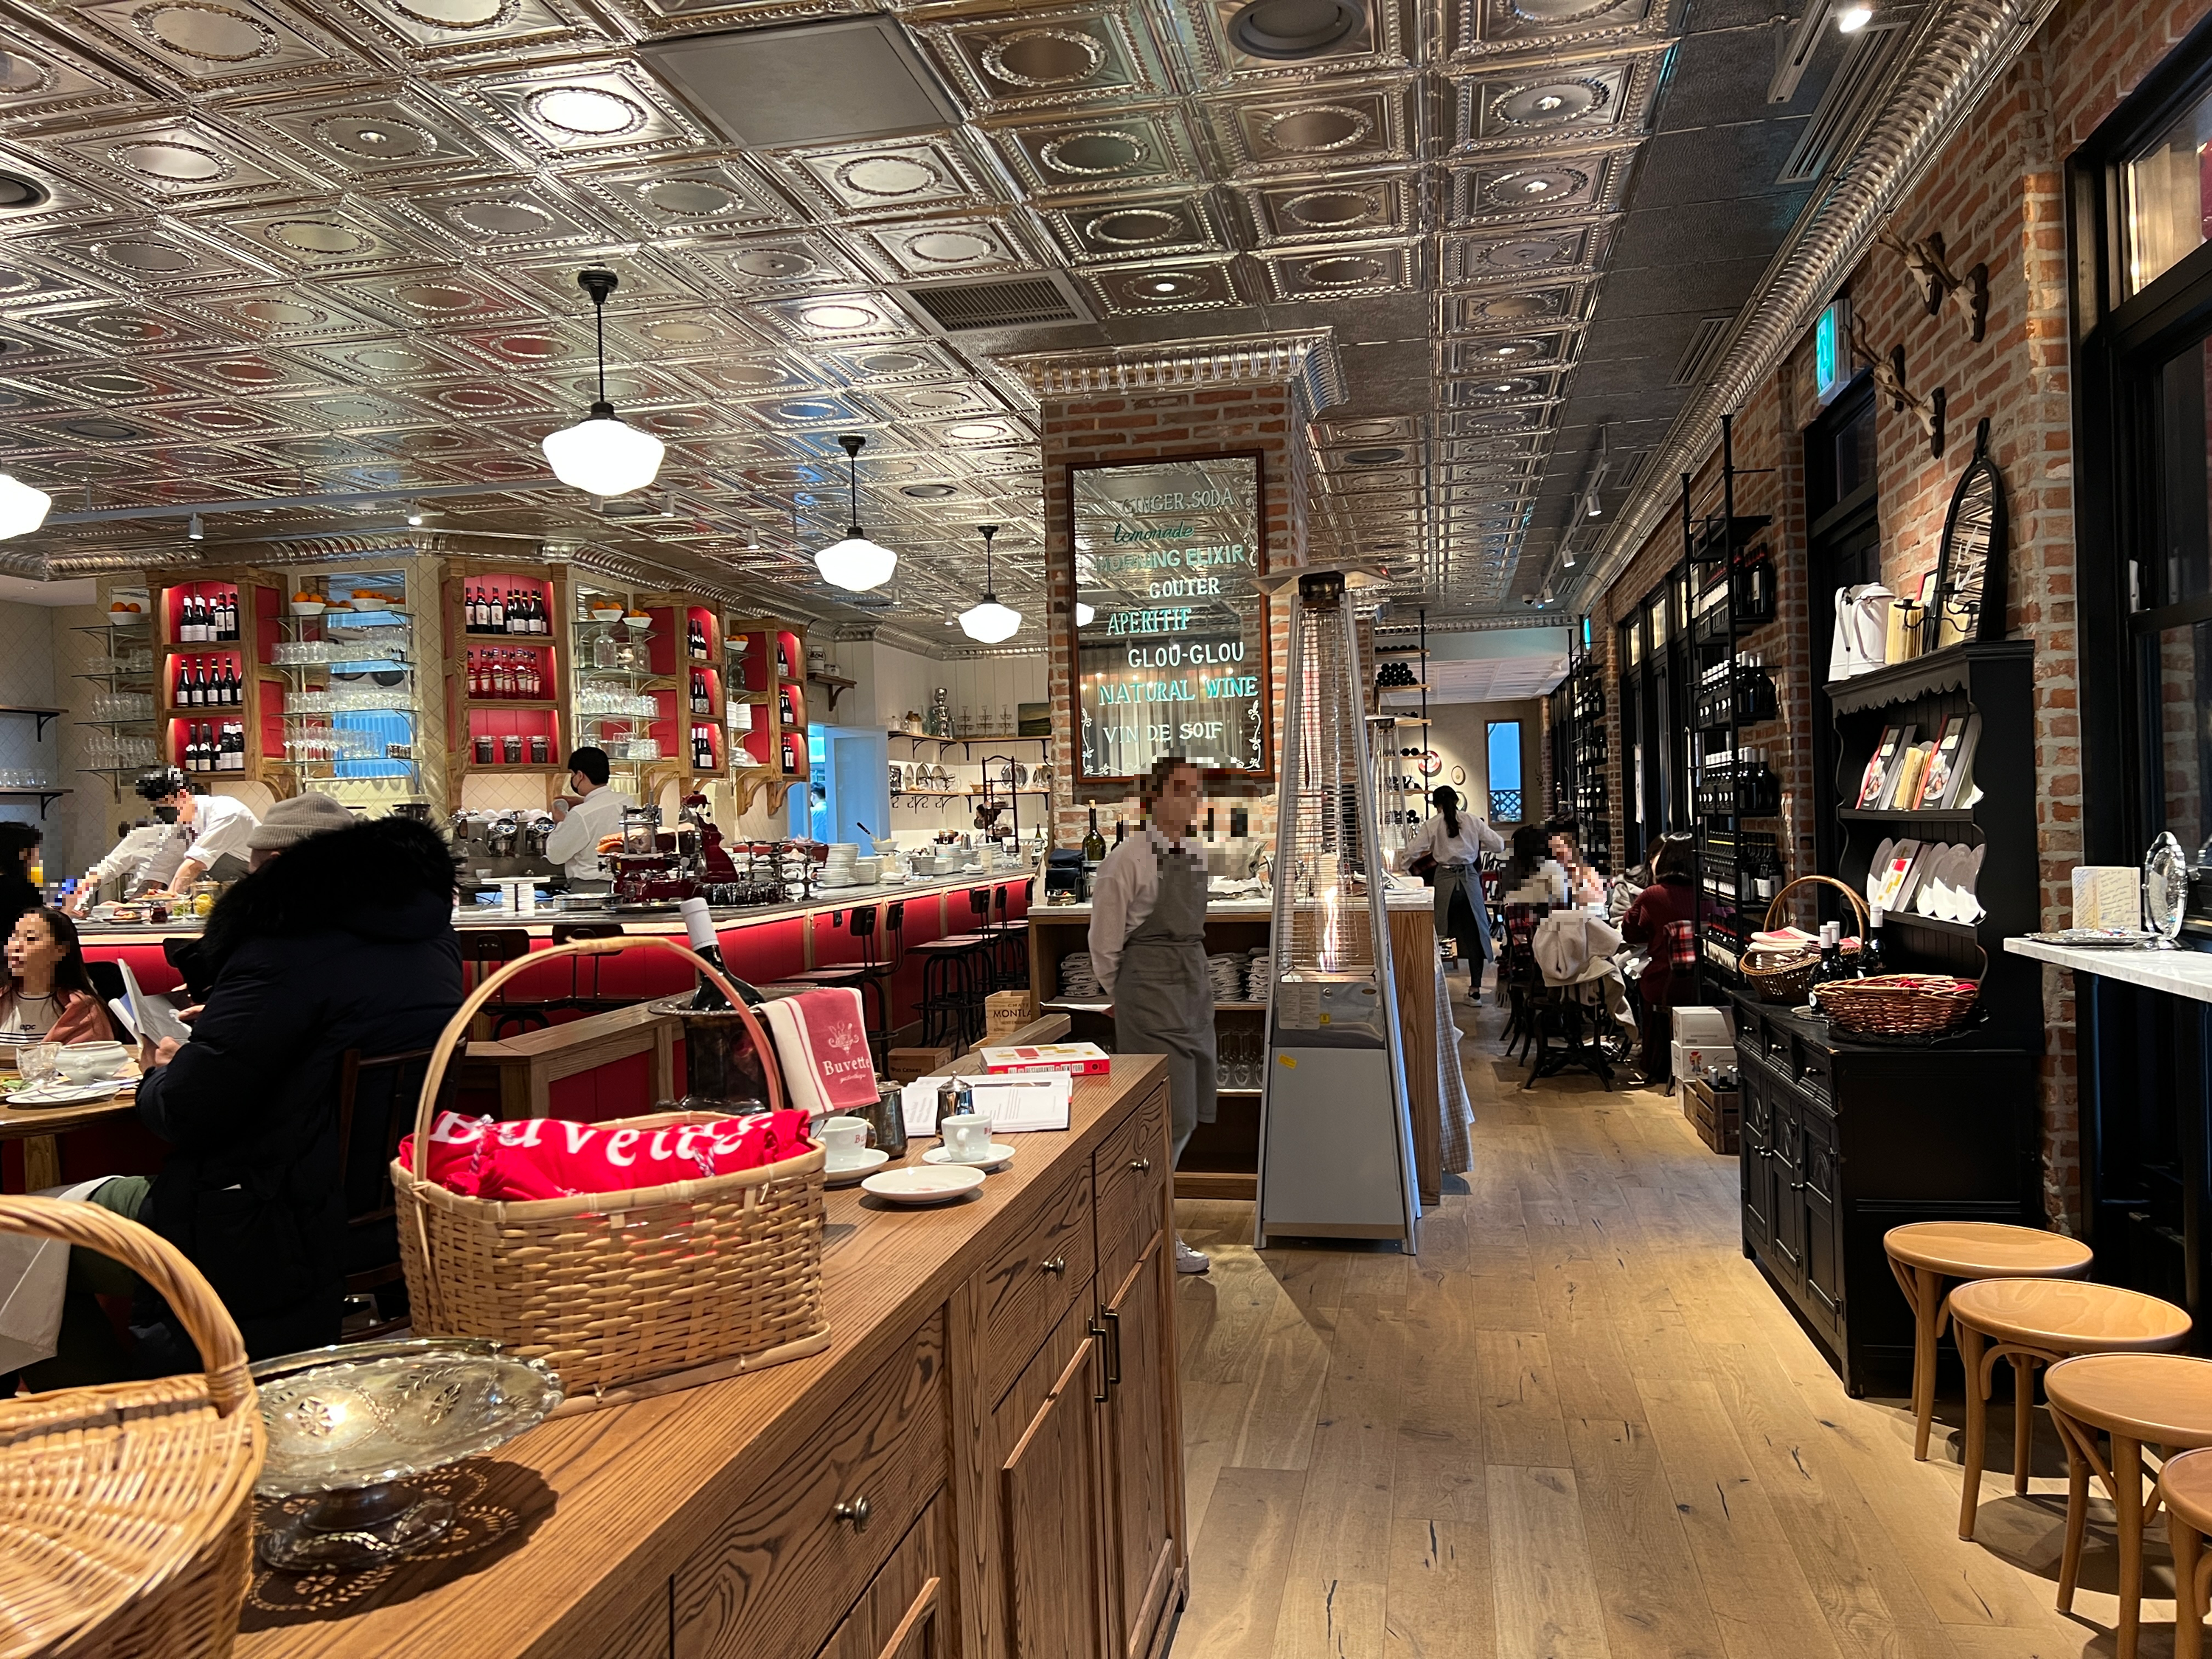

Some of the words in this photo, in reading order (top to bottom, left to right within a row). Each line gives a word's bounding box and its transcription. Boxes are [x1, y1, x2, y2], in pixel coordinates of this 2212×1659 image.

[1191, 487, 1235, 509] SODA
[1113, 521, 1194, 543] lemonade
[1096, 549, 1180, 573] MORNING
[1185, 543, 1246, 568] ELIXIR
[1149, 577, 1221, 599] GOUTER
[1106, 607, 1192, 636] APERITIF
[1127, 641, 1245, 668] GLOU-GLOU
[1099, 679, 1196, 706] NATURAL
[1204, 675, 1259, 699] WINE
[1102, 726, 1138, 744] VIN
[1147, 723, 1172, 742] DE
[1179, 721, 1223, 740] SOIF
[822, 1056, 871, 1076] Buvette
